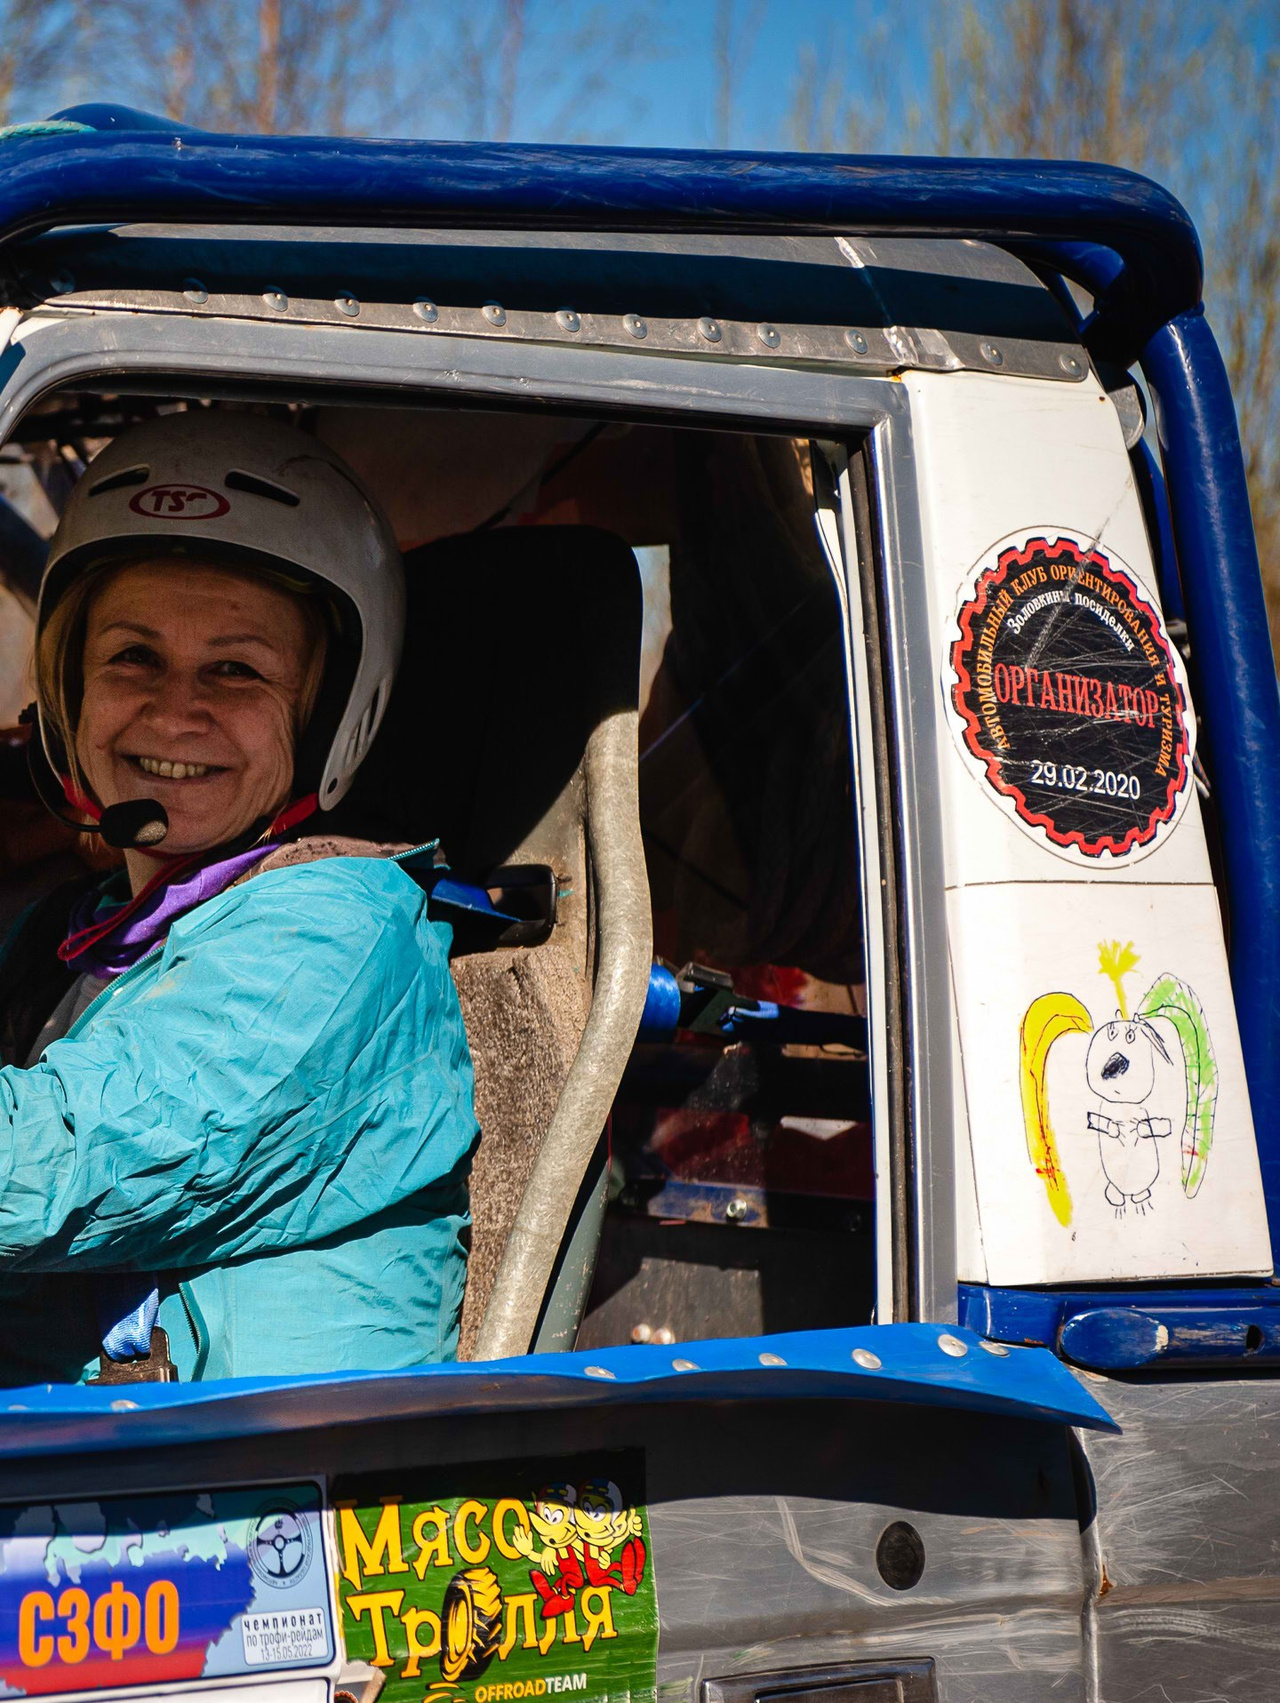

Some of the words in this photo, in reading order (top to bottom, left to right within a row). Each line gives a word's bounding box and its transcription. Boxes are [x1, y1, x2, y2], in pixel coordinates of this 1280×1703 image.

[1010, 566, 1048, 596] КЛУБ
[1074, 592, 1135, 652] посиделки
[975, 588, 1015, 750] АВТОМОБИЛЬНЫЙ
[1154, 672, 1165, 687] И
[994, 662, 1160, 730] ОРГАНИЗАТОР
[1154, 693, 1173, 779] ТУРИЗМА
[1031, 759, 1142, 801] 29.02.2020
[19, 1579, 180, 1668] СЗФО
[244, 1613, 322, 1631] чемпионат
[246, 1634, 258, 1648] по
[260, 1628, 323, 1649] трофи-рейдам
[475, 1673, 588, 1703] OFFROADTEAM
